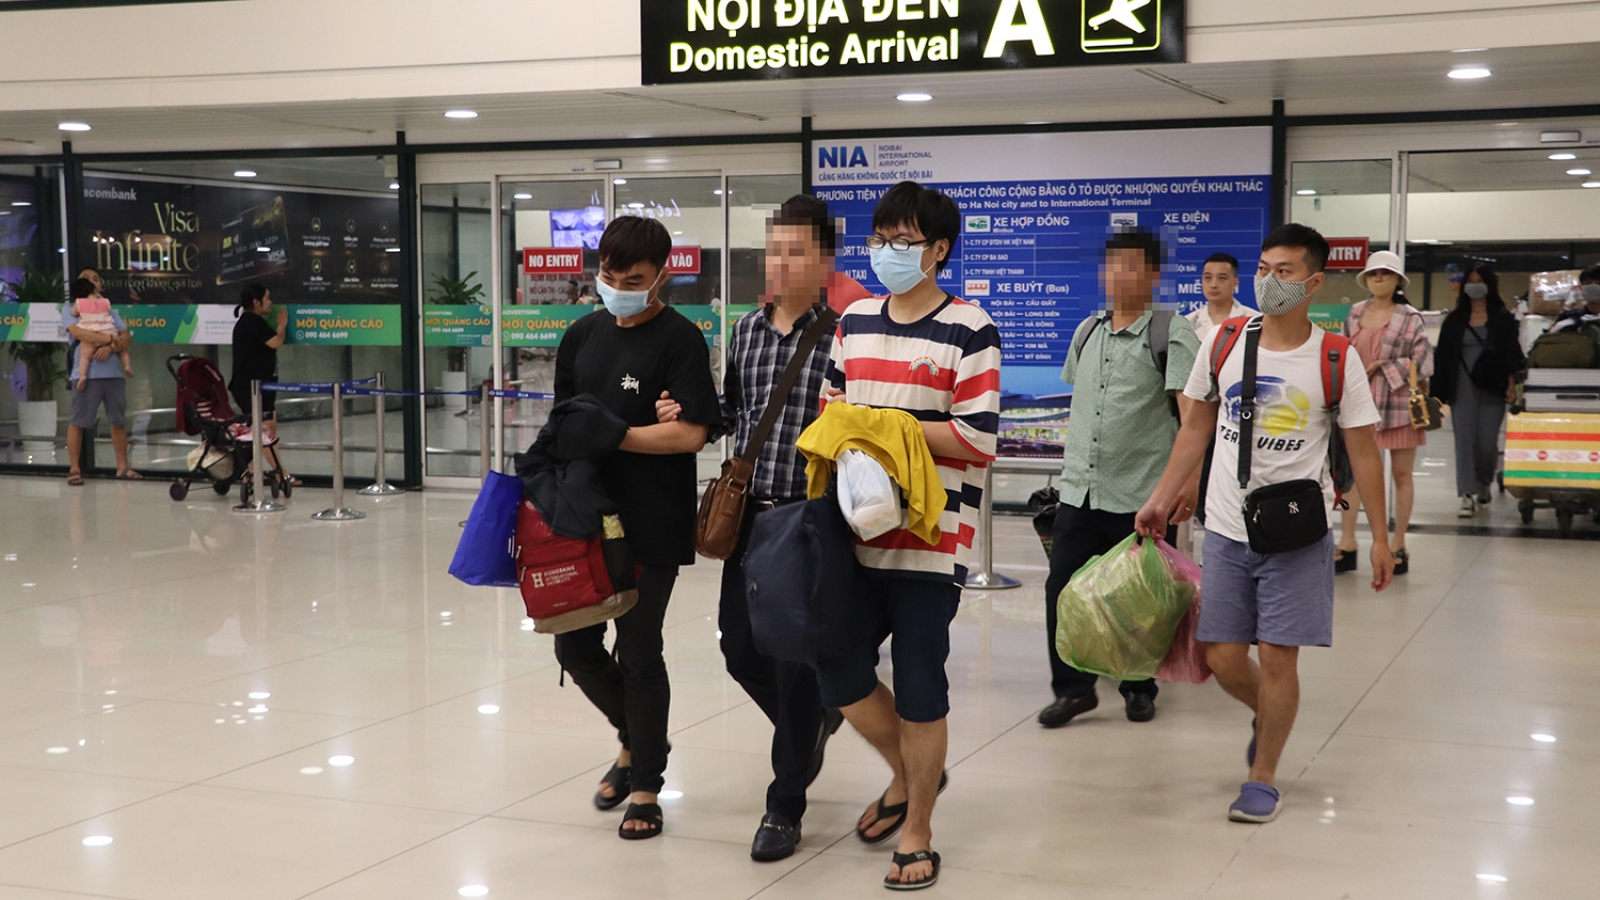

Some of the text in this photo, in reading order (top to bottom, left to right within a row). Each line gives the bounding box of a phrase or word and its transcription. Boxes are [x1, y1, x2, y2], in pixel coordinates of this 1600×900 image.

[983, 0, 1056, 58] A
[669, 28, 959, 73] Domestic Arrival
[818, 146, 868, 169] NIA
[837, 171, 856, 181] HÀNG
[857, 170, 880, 180] KHÔNG
[880, 169, 898, 180] QUỐC
[908, 169, 919, 180] NỘI
[921, 169, 933, 179] BÀI
[84, 187, 137, 200] acombank
[816, 189, 854, 202] PHƯƠNG
[856, 188, 878, 202] TIỆN
[943, 186, 977, 199] KHÁCH
[978, 185, 1007, 198] CÔNG
[1008, 185, 1037, 199] CỘNG
[1038, 182, 1067, 197] BẰNG
[1068, 183, 1077, 195] Ô
[1078, 183, 1092, 195] TÔ
[1093, 183, 1122, 198] ĐƯỢC
[1124, 183, 1168, 197] NHƯỢNG
[1170, 179, 1206, 194] QUYỀN
[1207, 182, 1233, 193] KHAI
[1235, 179, 1264, 192] THÁC
[970, 201, 982, 209] Ha
[1001, 201, 1018, 210] city
[1020, 200, 1037, 208] and
[1050, 199, 1109, 207] International
[1111, 198, 1152, 206] Terminal
[154, 202, 200, 234] Visa
[994, 212, 1070, 229] XE HỢP ĐỒNG
[1164, 210, 1210, 225] XE ĐIỆN
[96, 229, 200, 272] Infinite
[1328, 246, 1363, 261] NTRY
[529, 254, 579, 268] NO ENTRY
[671, 252, 693, 267] VÀO
[852, 269, 867, 280] TAXI
[997, 281, 1070, 294] XE BUÝT (Bus)
[991, 299, 1002, 307] NỘI
[4, 315, 25, 326] CÁO
[122, 316, 167, 328] ẢNG CÁO
[296, 316, 384, 329] MỜI QUẢNG CÁO
[425, 316, 490, 327] MỜI QUẢNG CÁO
[502, 316, 567, 331] MỜI QUẢNG
[332, 331, 348, 339] 6699
[1220, 425, 1305, 451] TEA VIBES
